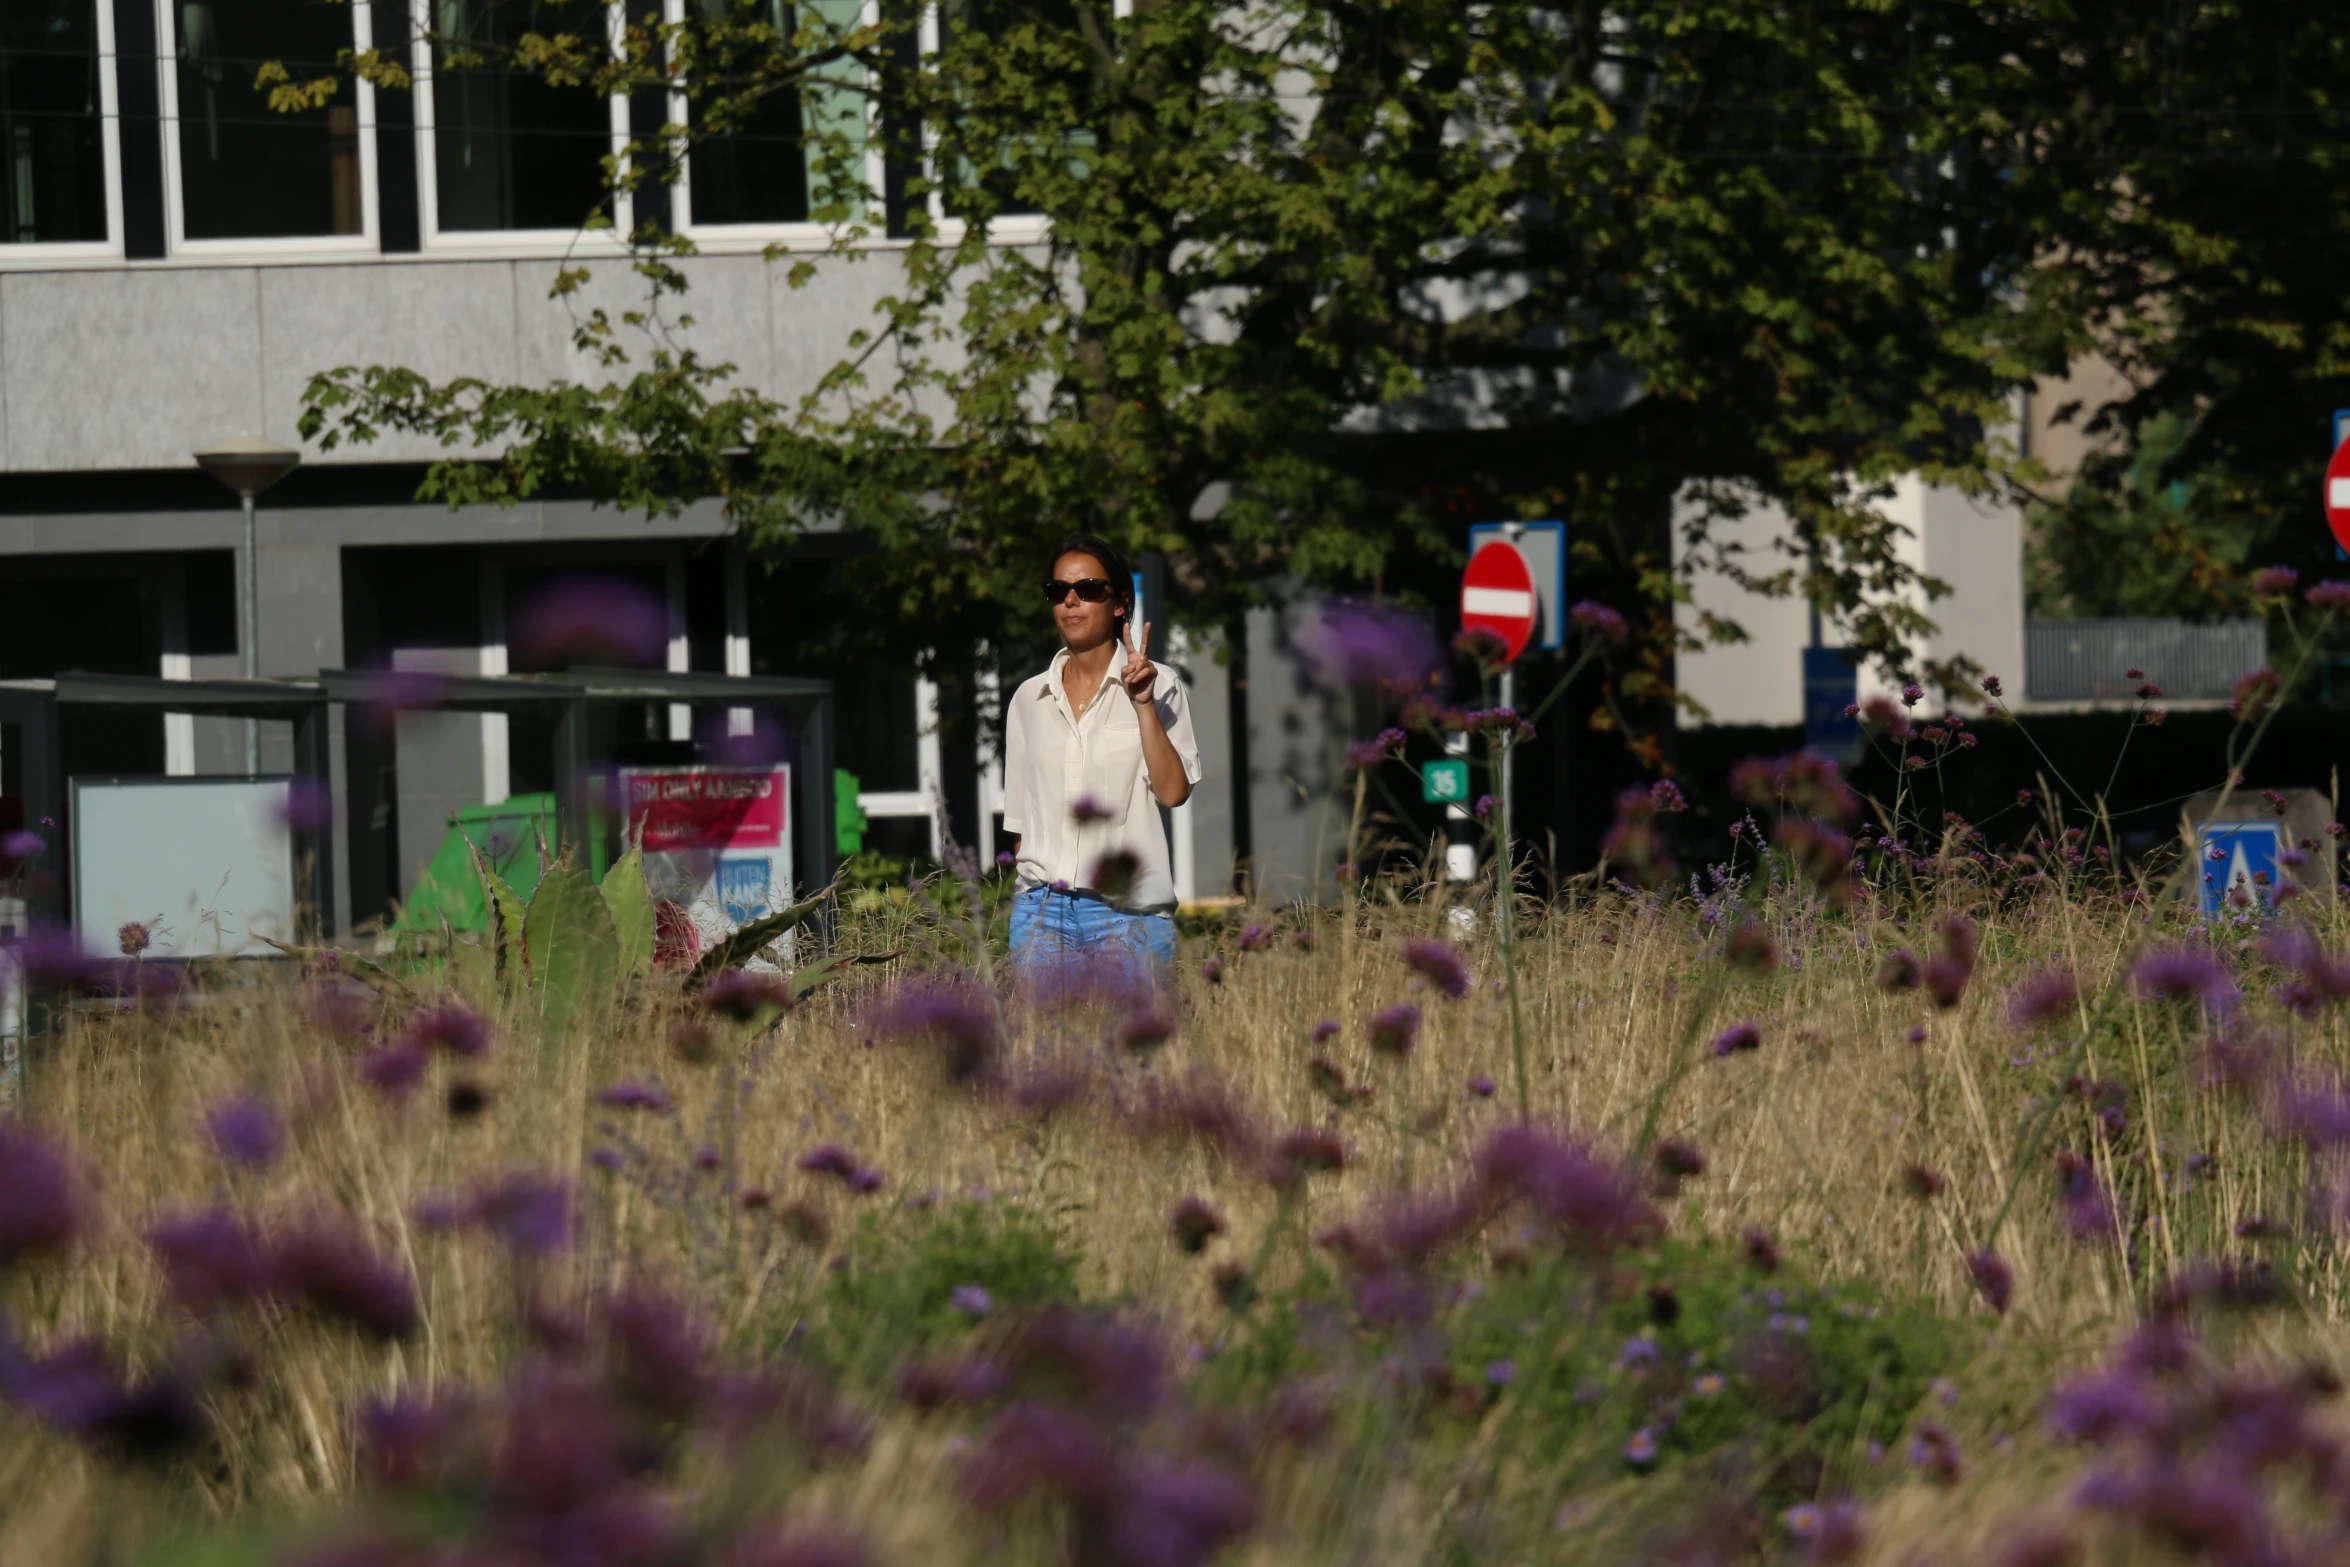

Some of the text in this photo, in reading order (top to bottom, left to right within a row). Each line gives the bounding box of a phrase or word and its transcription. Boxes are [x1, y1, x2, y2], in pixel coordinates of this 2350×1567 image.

[632, 780, 660, 803] SIM
[662, 778, 702, 801] ONLY
[721, 864, 767, 883] BUITEN
